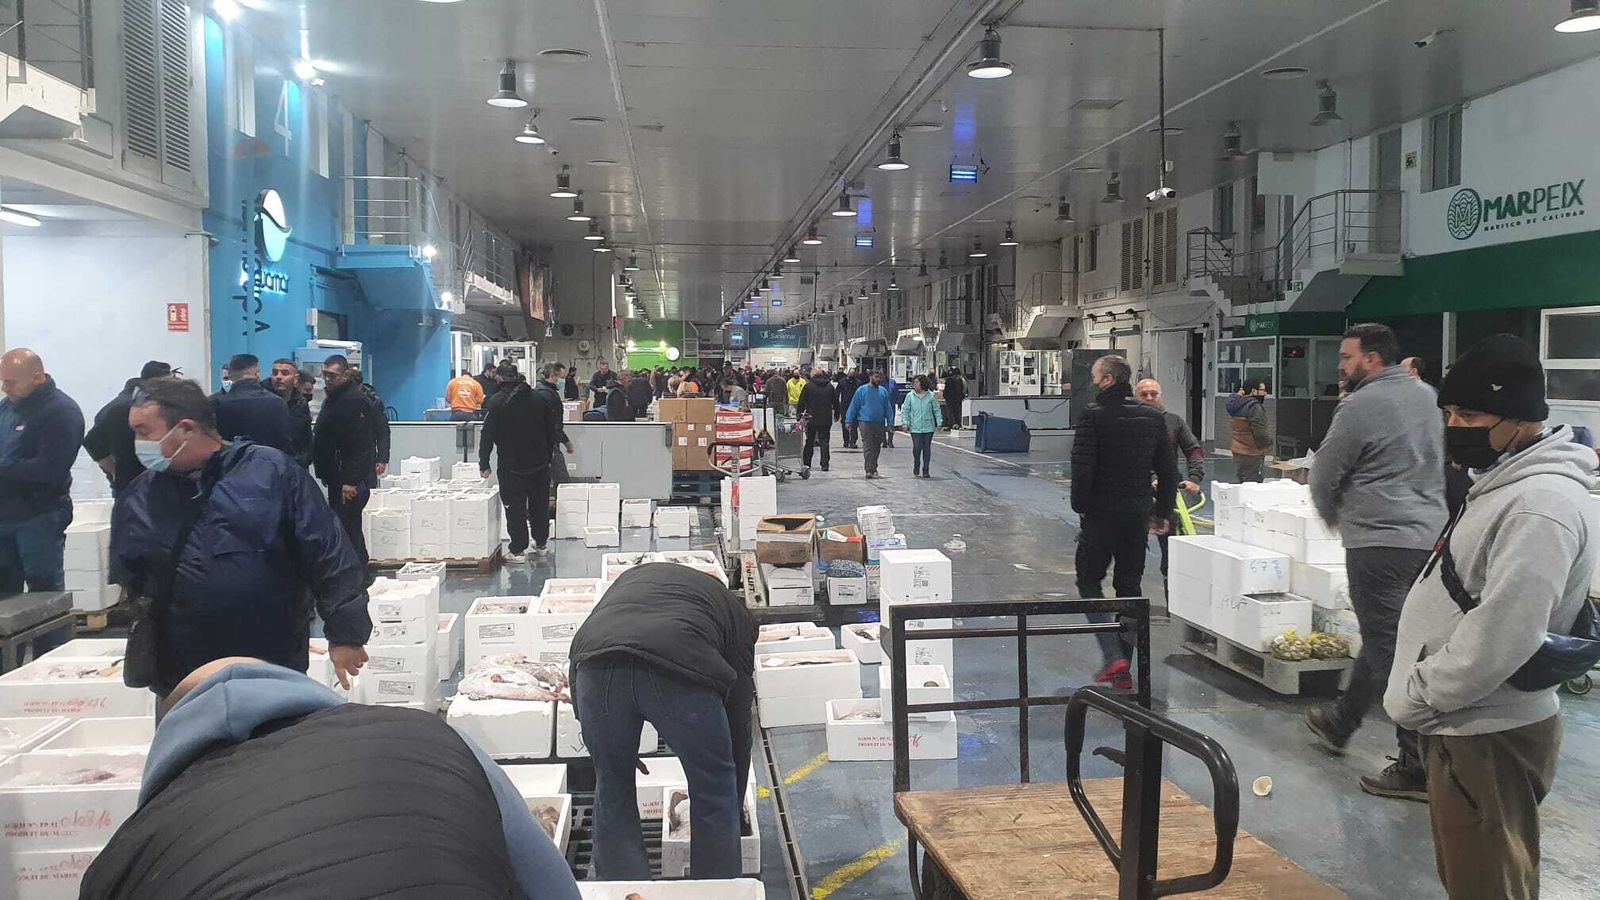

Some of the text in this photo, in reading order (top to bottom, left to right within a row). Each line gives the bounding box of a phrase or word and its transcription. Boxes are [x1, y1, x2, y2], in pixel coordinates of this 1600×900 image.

[1483, 179, 1585, 222] MARPEIX
[1484, 220, 1521, 231] MARISCO
[1542, 209, 1585, 222] CALIDAD
